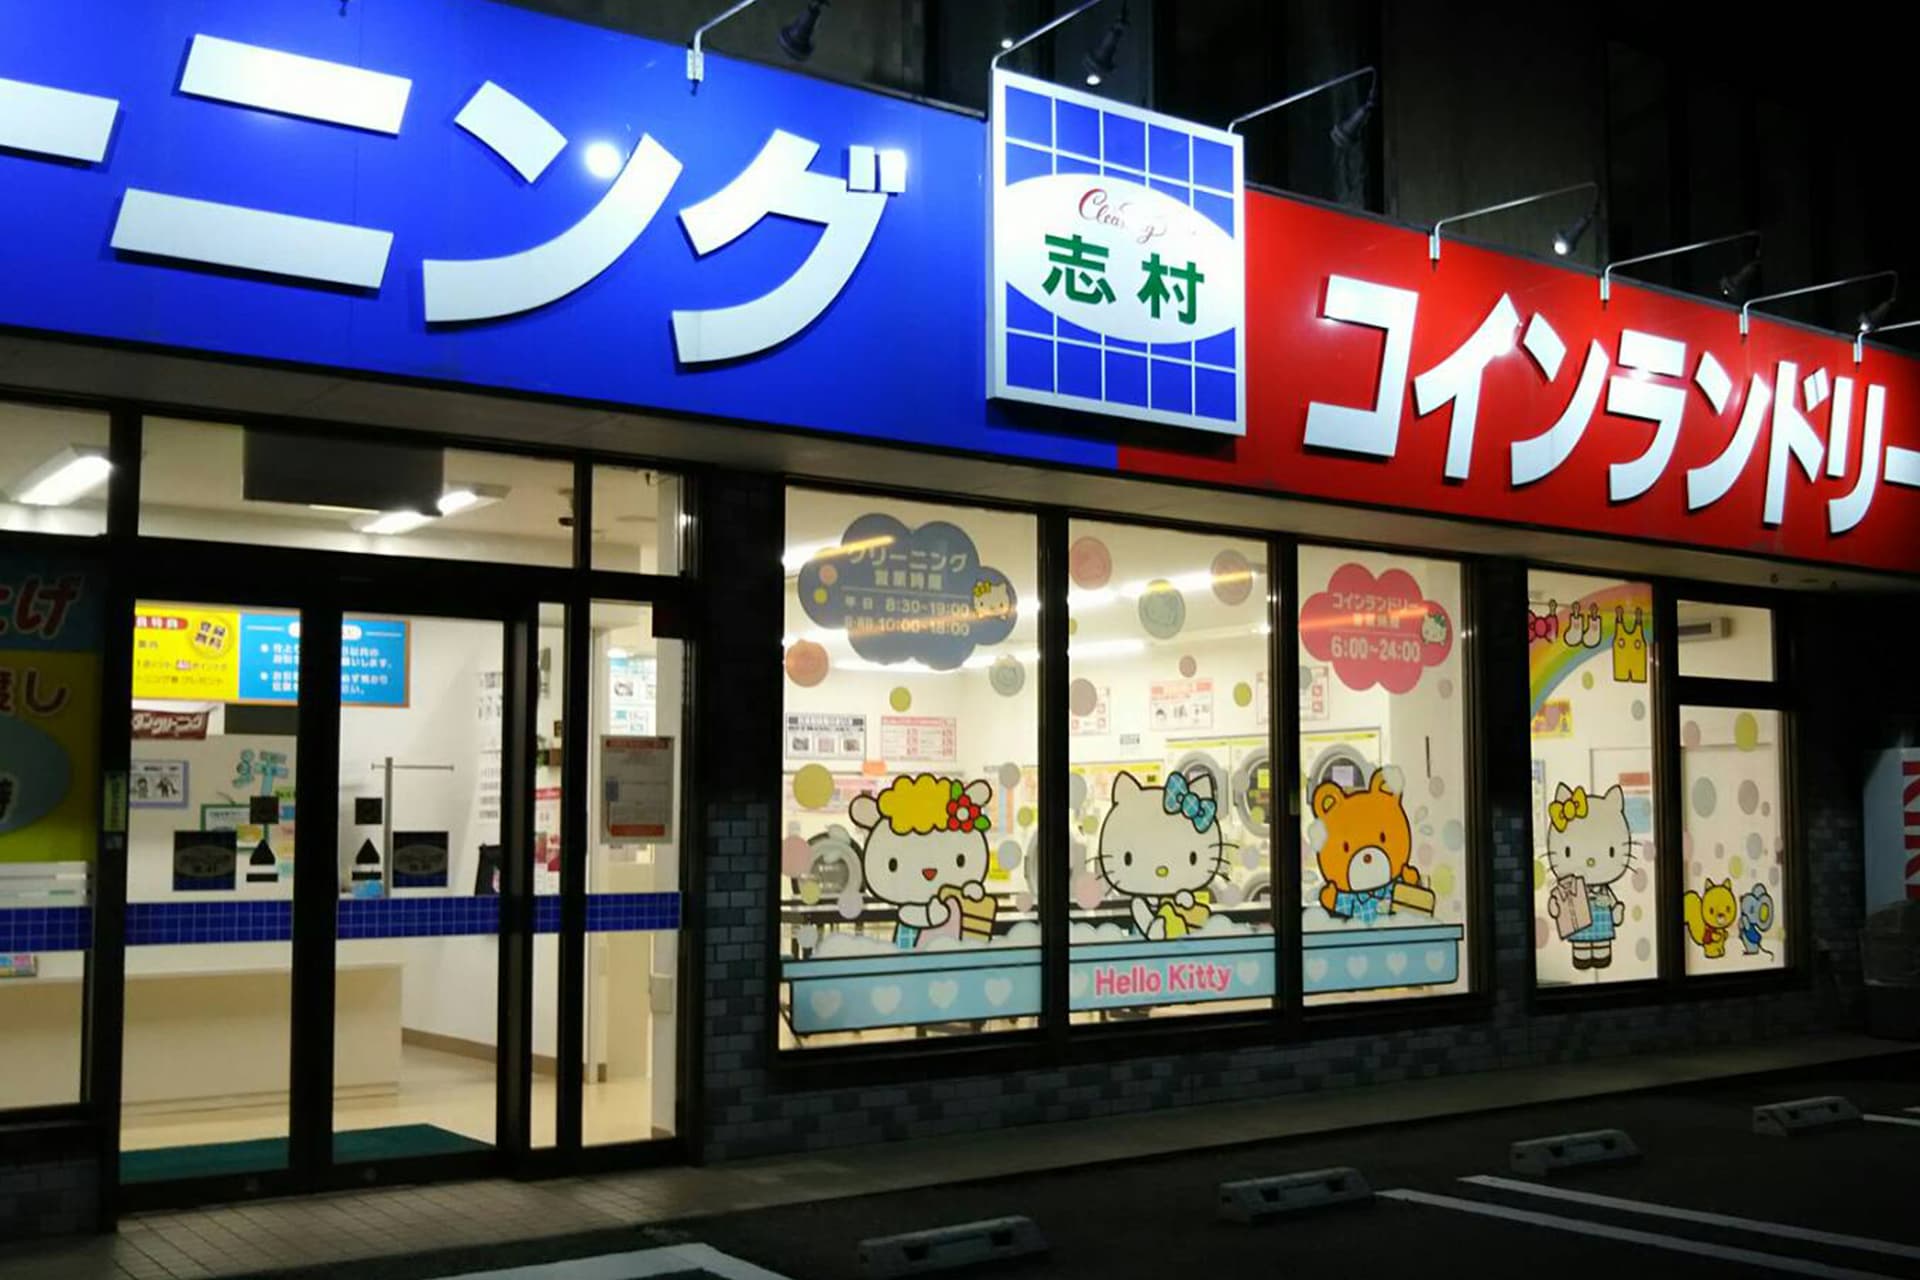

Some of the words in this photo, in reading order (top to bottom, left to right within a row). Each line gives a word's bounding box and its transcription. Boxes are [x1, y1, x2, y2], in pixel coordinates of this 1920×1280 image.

[1078, 187, 1168, 245] Cleag
[1042, 234, 1205, 325] 志村
[1303, 274, 1920, 534] コインランドリー
[1094, 964, 1162, 997] Hello
[1168, 960, 1232, 993] Kitty
